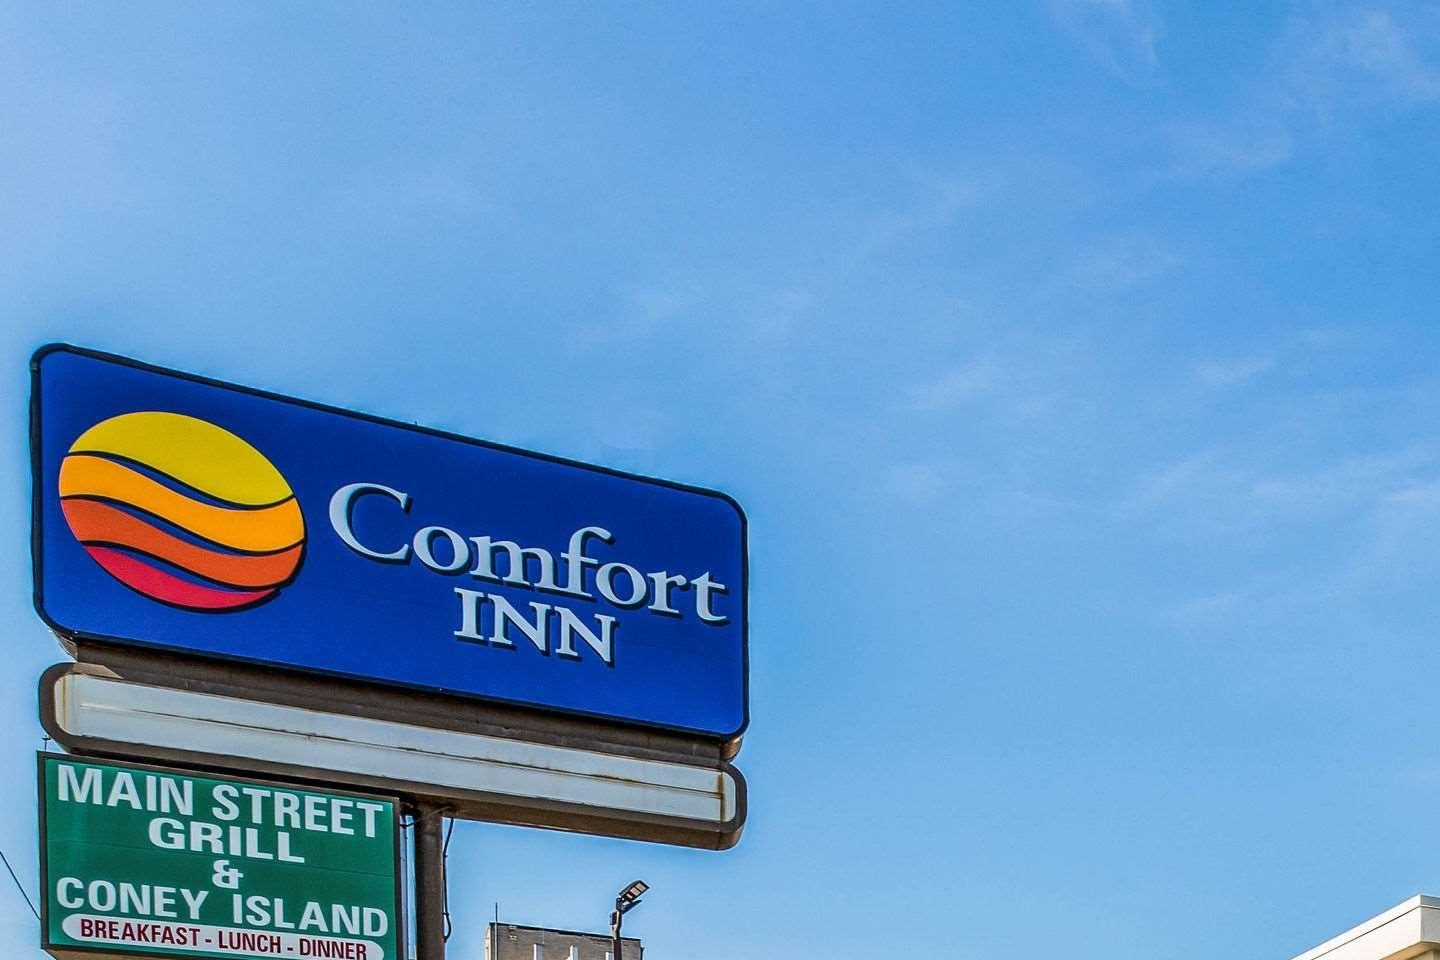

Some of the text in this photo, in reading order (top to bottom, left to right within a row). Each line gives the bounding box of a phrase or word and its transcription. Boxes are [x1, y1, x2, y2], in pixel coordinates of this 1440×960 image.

[328, 481, 729, 623] Comfort
[453, 586, 617, 664] INN
[57, 764, 384, 839] MAIN STREET
[148, 817, 305, 863] GRILL
[211, 859, 244, 889] &
[56, 876, 389, 938] CONEY ISLAND
[80, 918, 201, 947] BREAKFAST
[218, 930, 281, 954] LUNCH
[299, 938, 367, 960] DINNER
